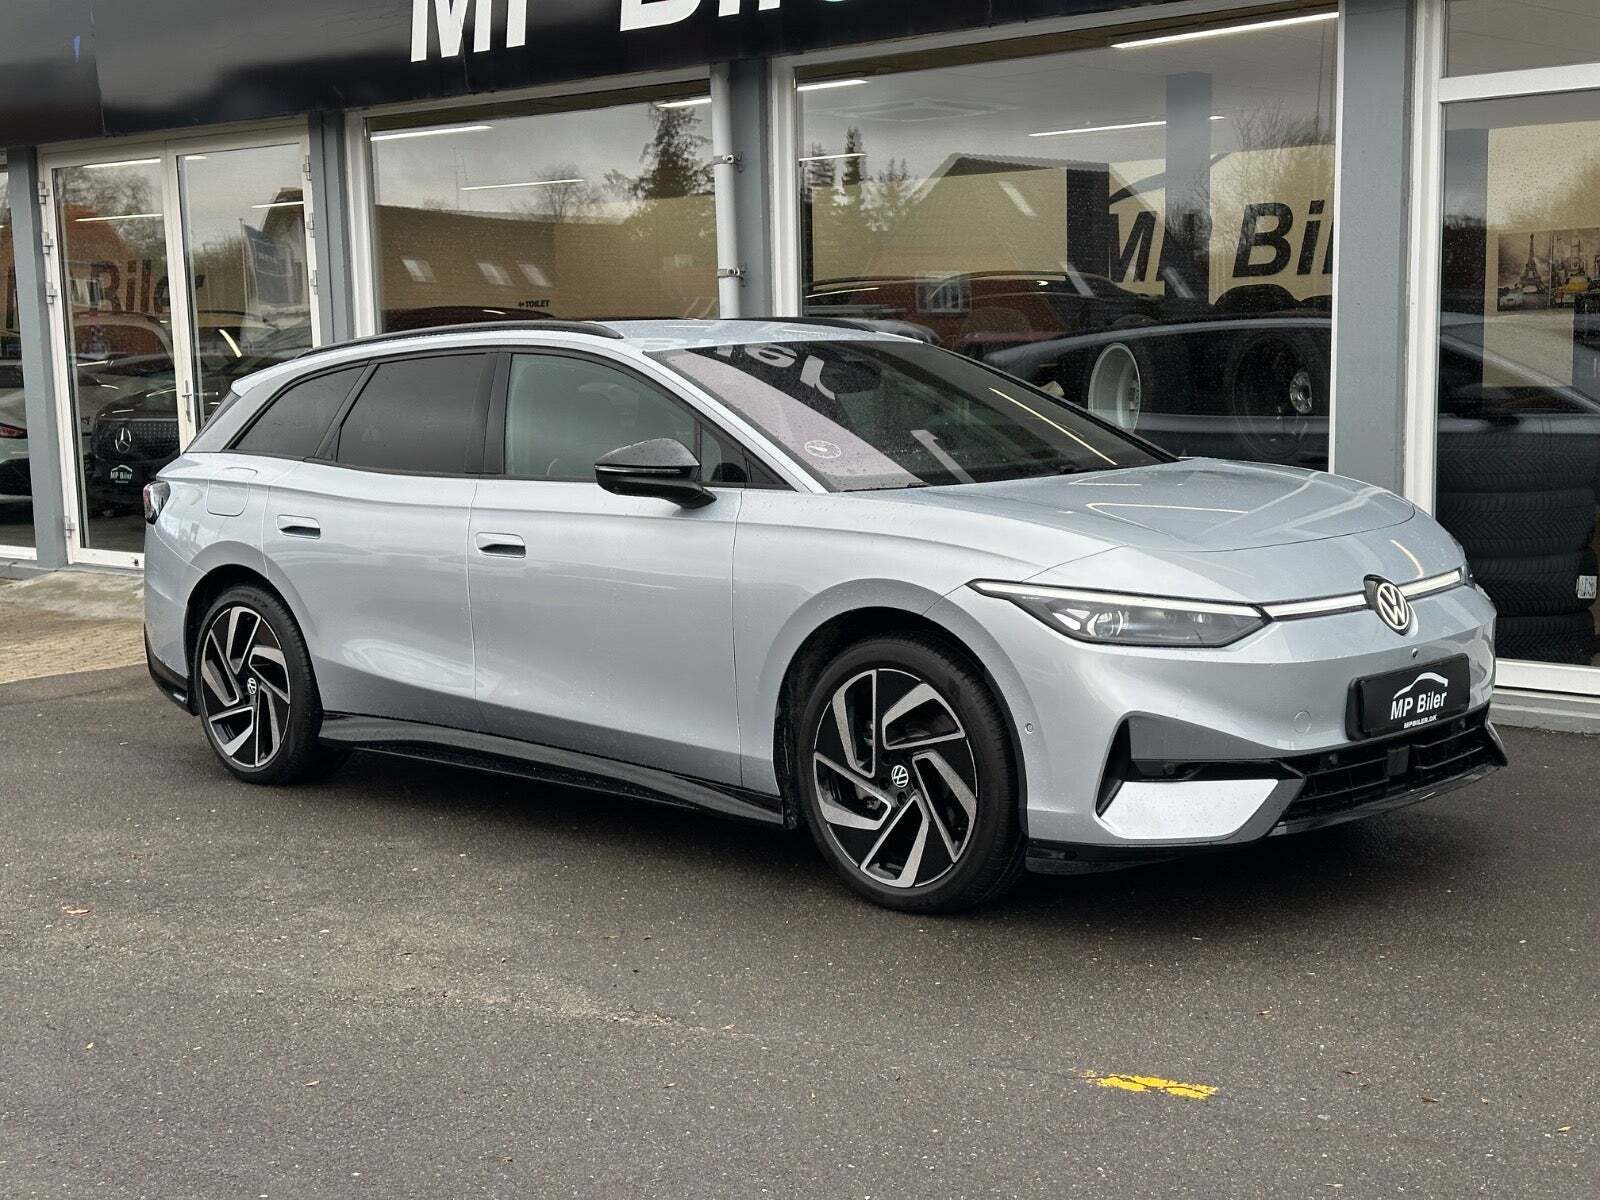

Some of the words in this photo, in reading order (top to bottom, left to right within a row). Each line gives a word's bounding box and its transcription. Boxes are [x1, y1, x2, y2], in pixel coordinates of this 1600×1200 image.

[525, 299, 550, 308] TOILET
[1390, 697, 1414, 721] MP
[1416, 691, 1448, 714] Biler
